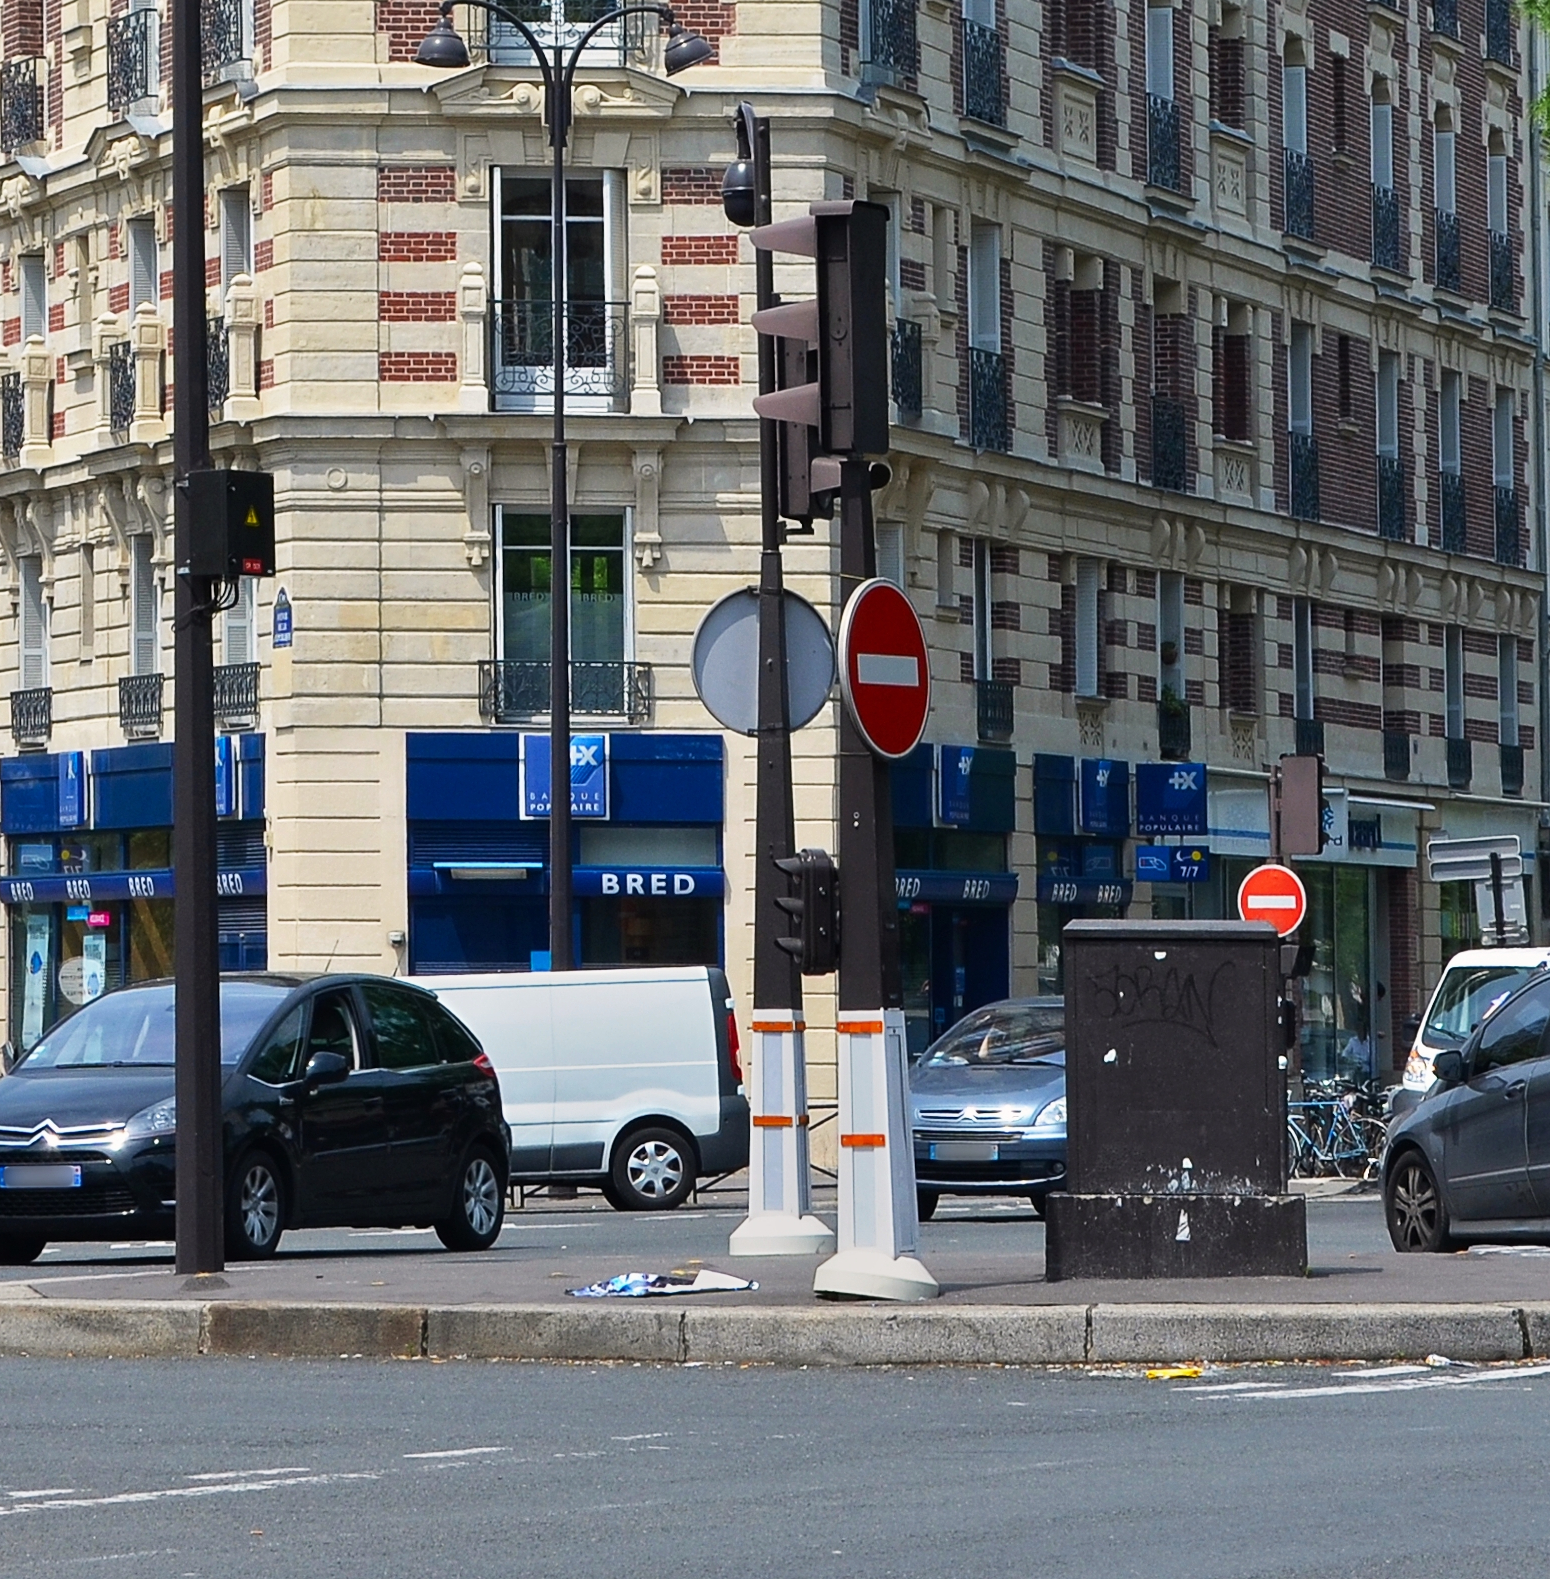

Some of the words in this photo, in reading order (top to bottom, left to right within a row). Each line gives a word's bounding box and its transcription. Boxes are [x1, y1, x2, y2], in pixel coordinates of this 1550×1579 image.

[530, 793, 599, 801] BAUE
[530, 803, 599, 812] POPAIRE
[1139, 814, 1199, 822] BANQUE
[1139, 824, 1200, 832] POPULAIRE
[1180, 866, 1200, 878] 7/7
[10, 882, 34, 901] BRED
[66, 879, 91, 899] BRED
[128, 876, 155, 897] BRED
[601, 873, 695, 895] BRED
[963, 879, 990, 899] BRED
[1051, 883, 1077, 902] BRED
[1097, 884, 1122, 903] BRED
